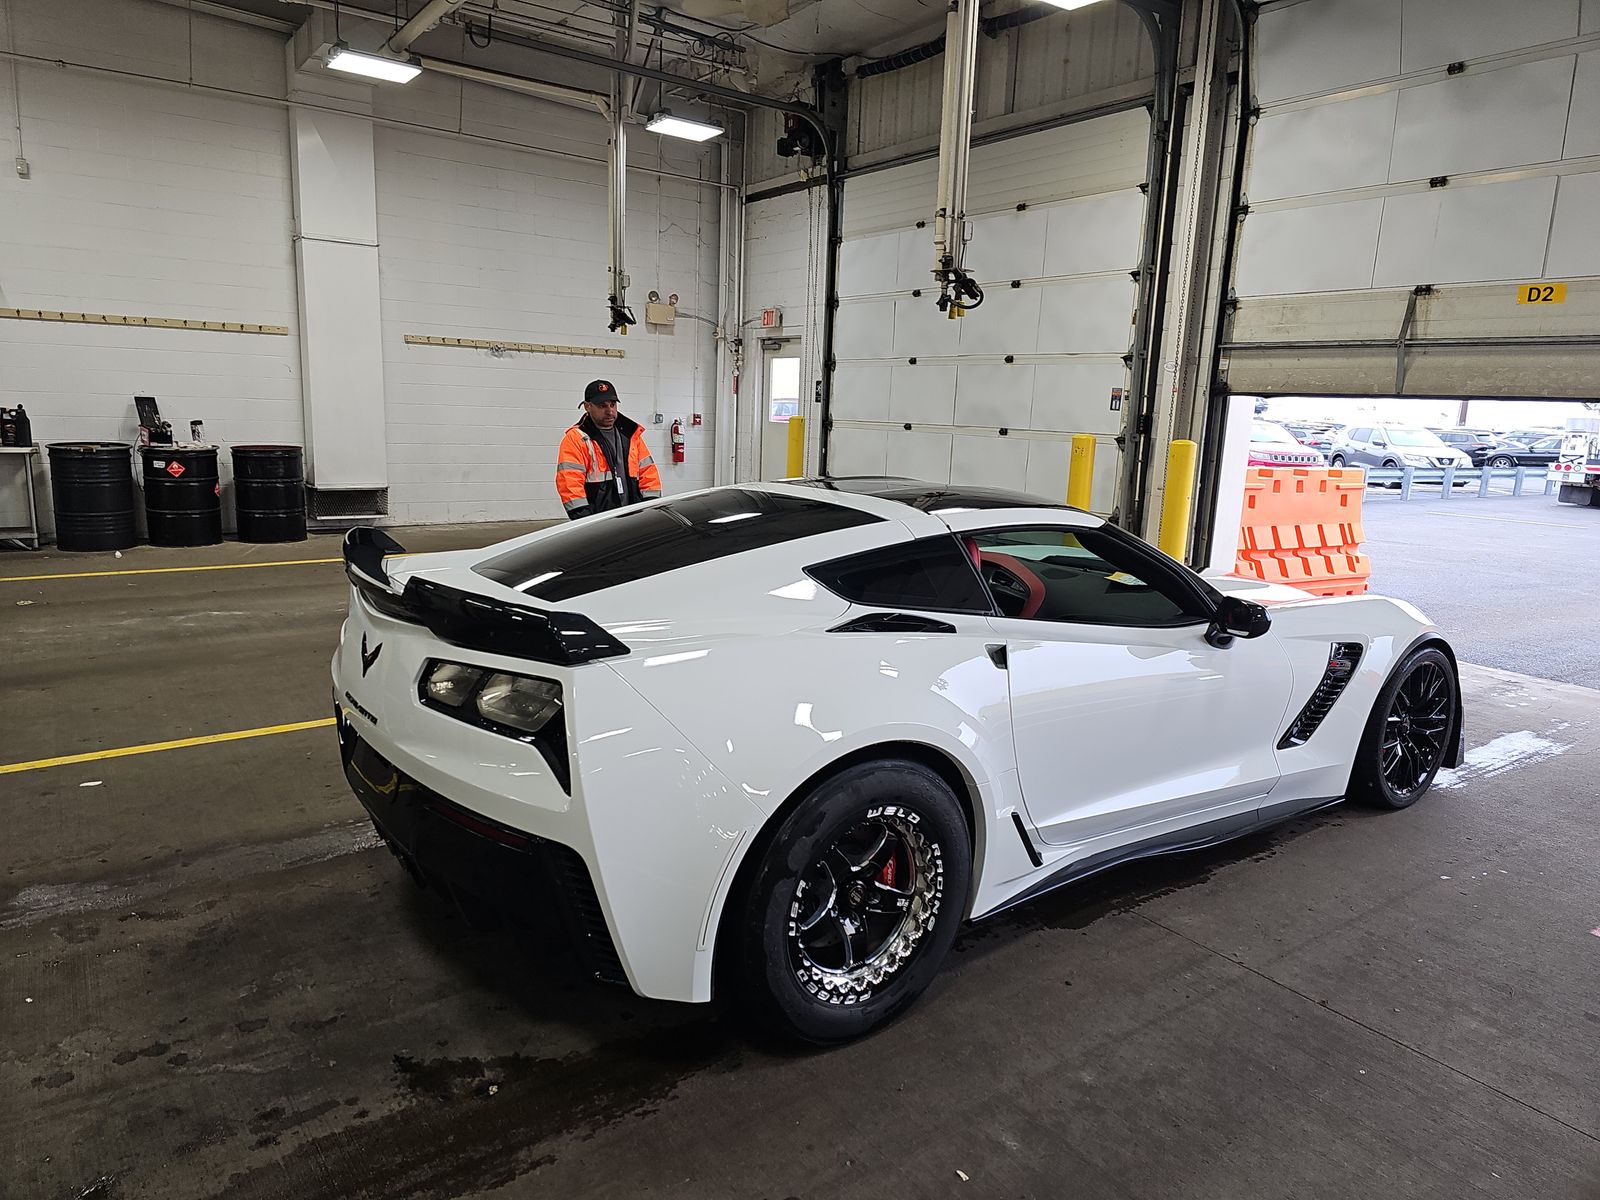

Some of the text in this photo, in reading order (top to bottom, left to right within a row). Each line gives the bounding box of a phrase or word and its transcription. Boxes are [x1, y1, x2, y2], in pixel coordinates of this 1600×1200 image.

[763, 310, 774, 326] EXIT
[1527, 287, 1555, 302] D2
[866, 806, 944, 932] WELD RACING
[788, 879, 872, 1005] FORGED USA
